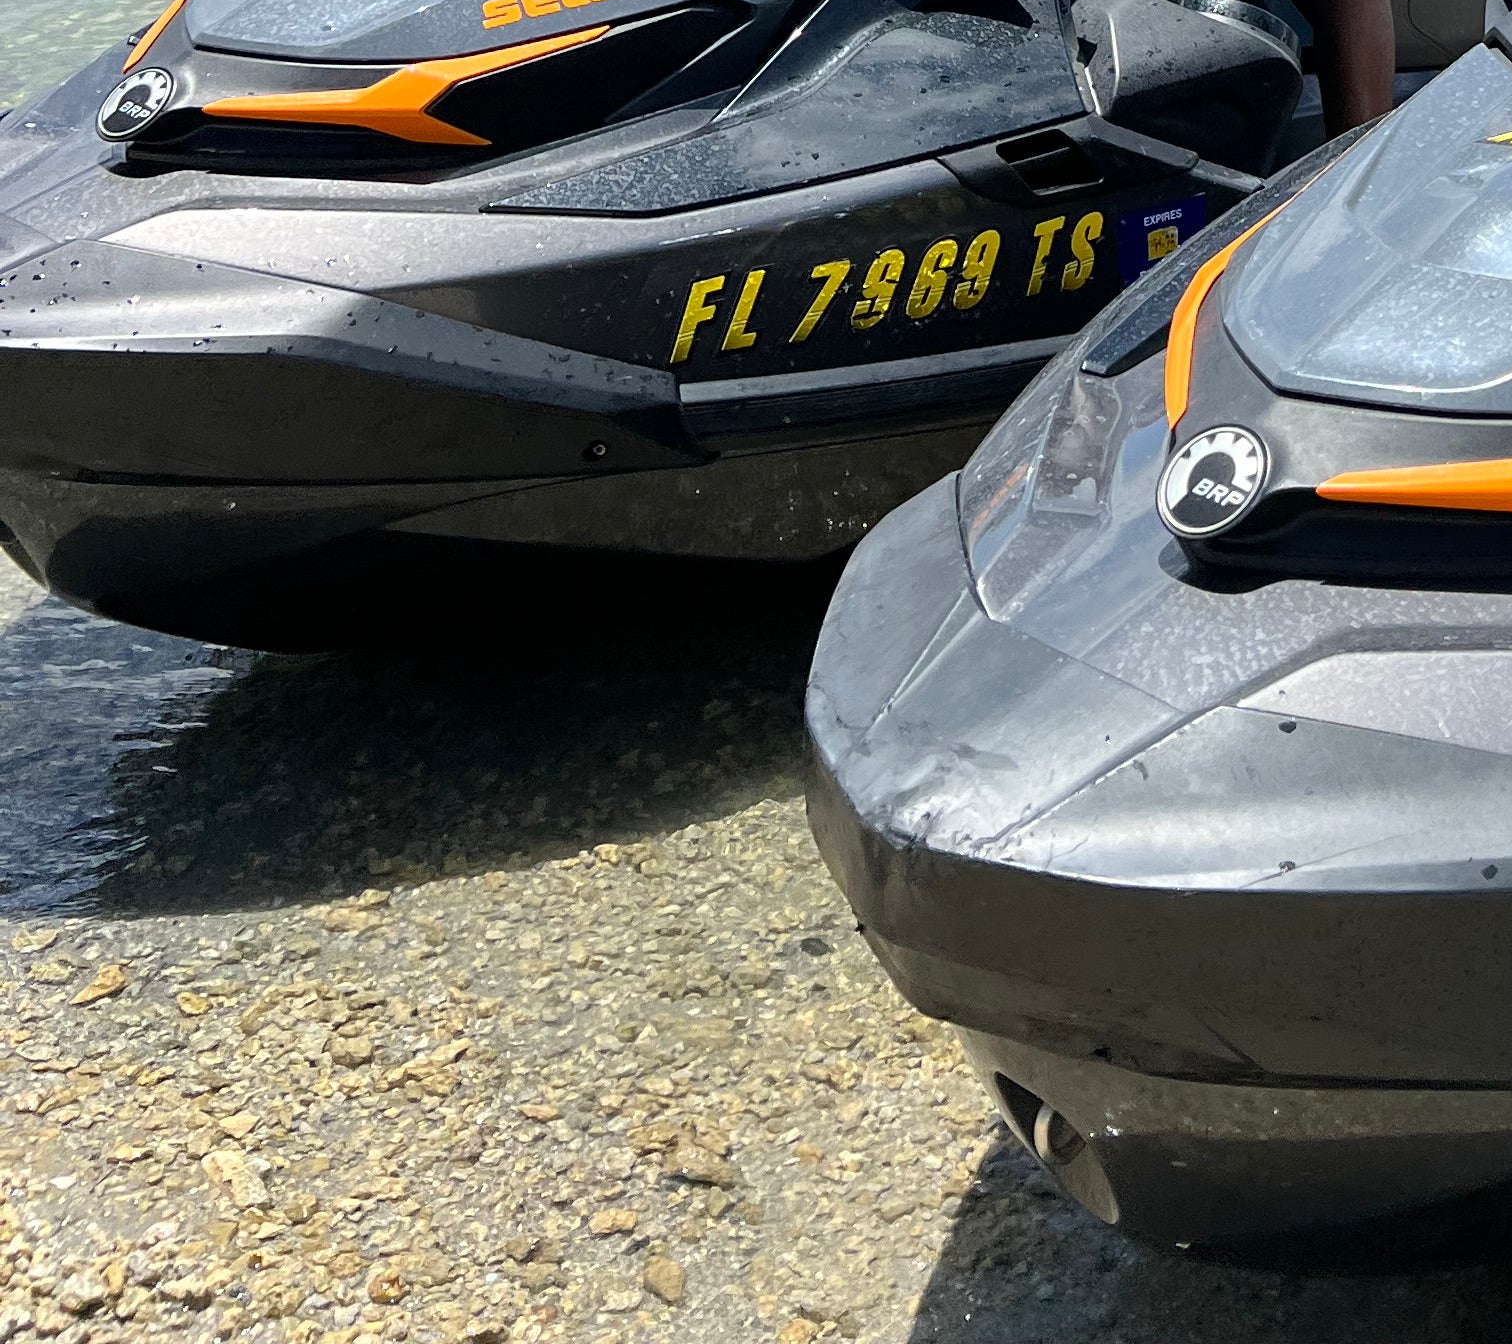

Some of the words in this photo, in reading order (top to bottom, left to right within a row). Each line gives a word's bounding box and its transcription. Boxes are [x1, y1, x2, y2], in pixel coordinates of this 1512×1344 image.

[119, 100, 151, 119] BRP
[1143, 208, 1183, 227] EXPIRES
[669, 268, 767, 365] FL
[788, 228, 1001, 344] 7969
[1026, 211, 1105, 297] TS
[1191, 477, 1245, 507] BRP
